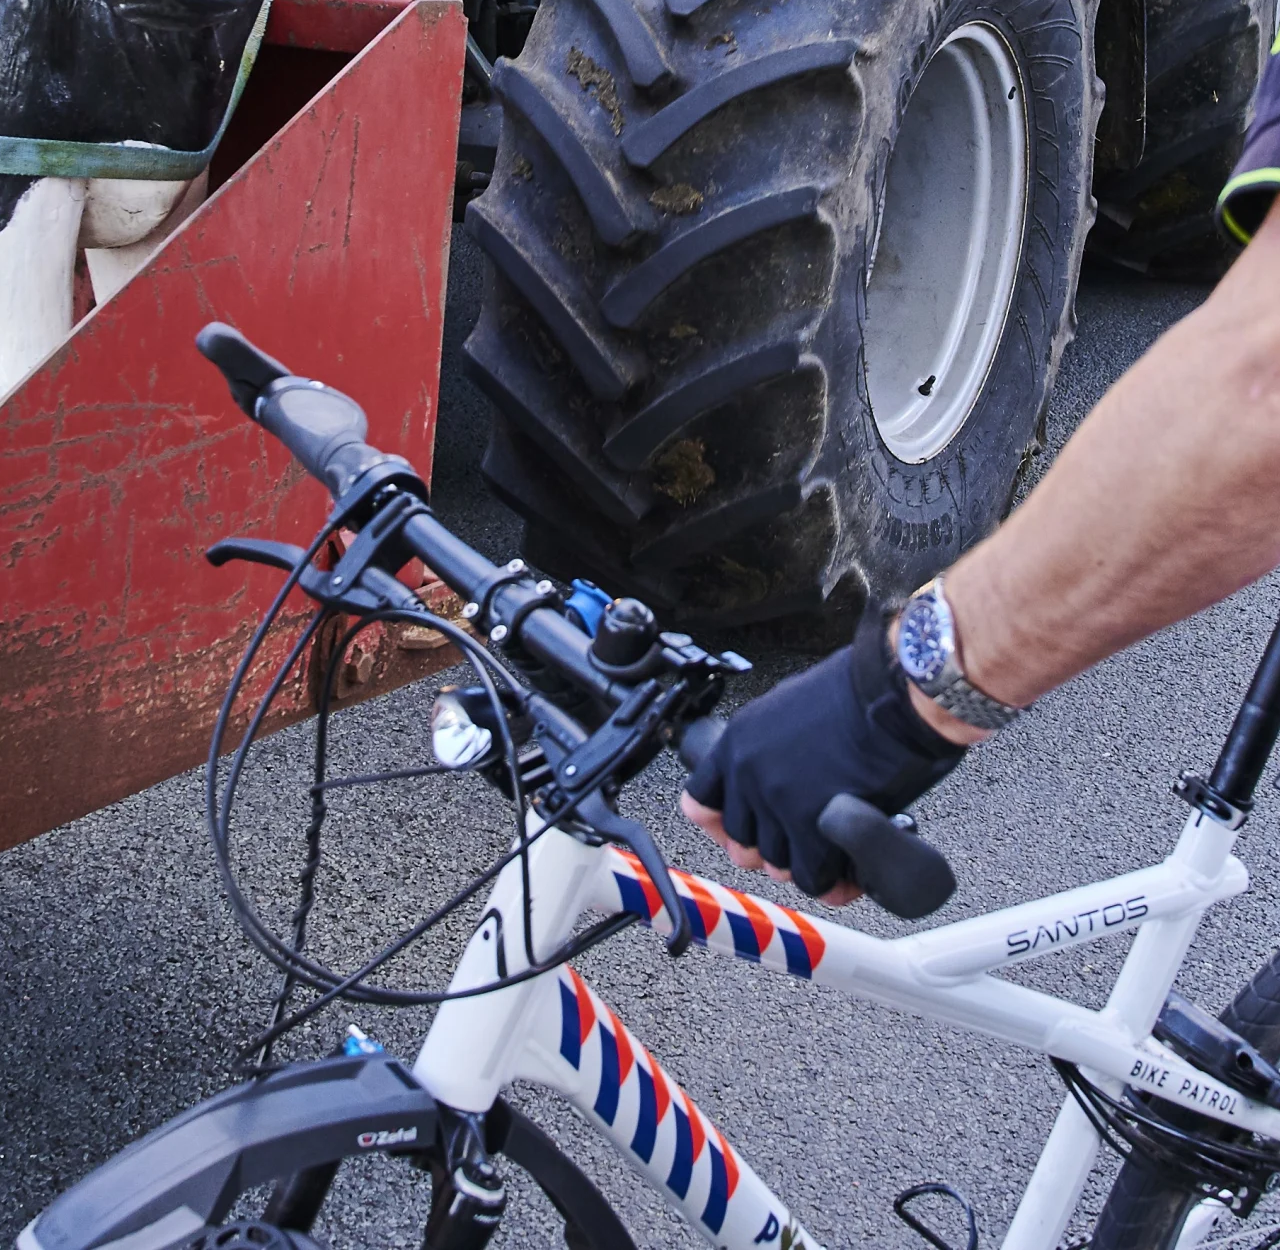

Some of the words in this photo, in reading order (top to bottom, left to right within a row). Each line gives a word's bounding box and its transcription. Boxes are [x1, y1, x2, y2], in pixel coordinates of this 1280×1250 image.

[1007, 896, 1148, 956] SANTOS
[1130, 1060, 1170, 1088] BIKE
[1179, 1079, 1236, 1115] PATROL
